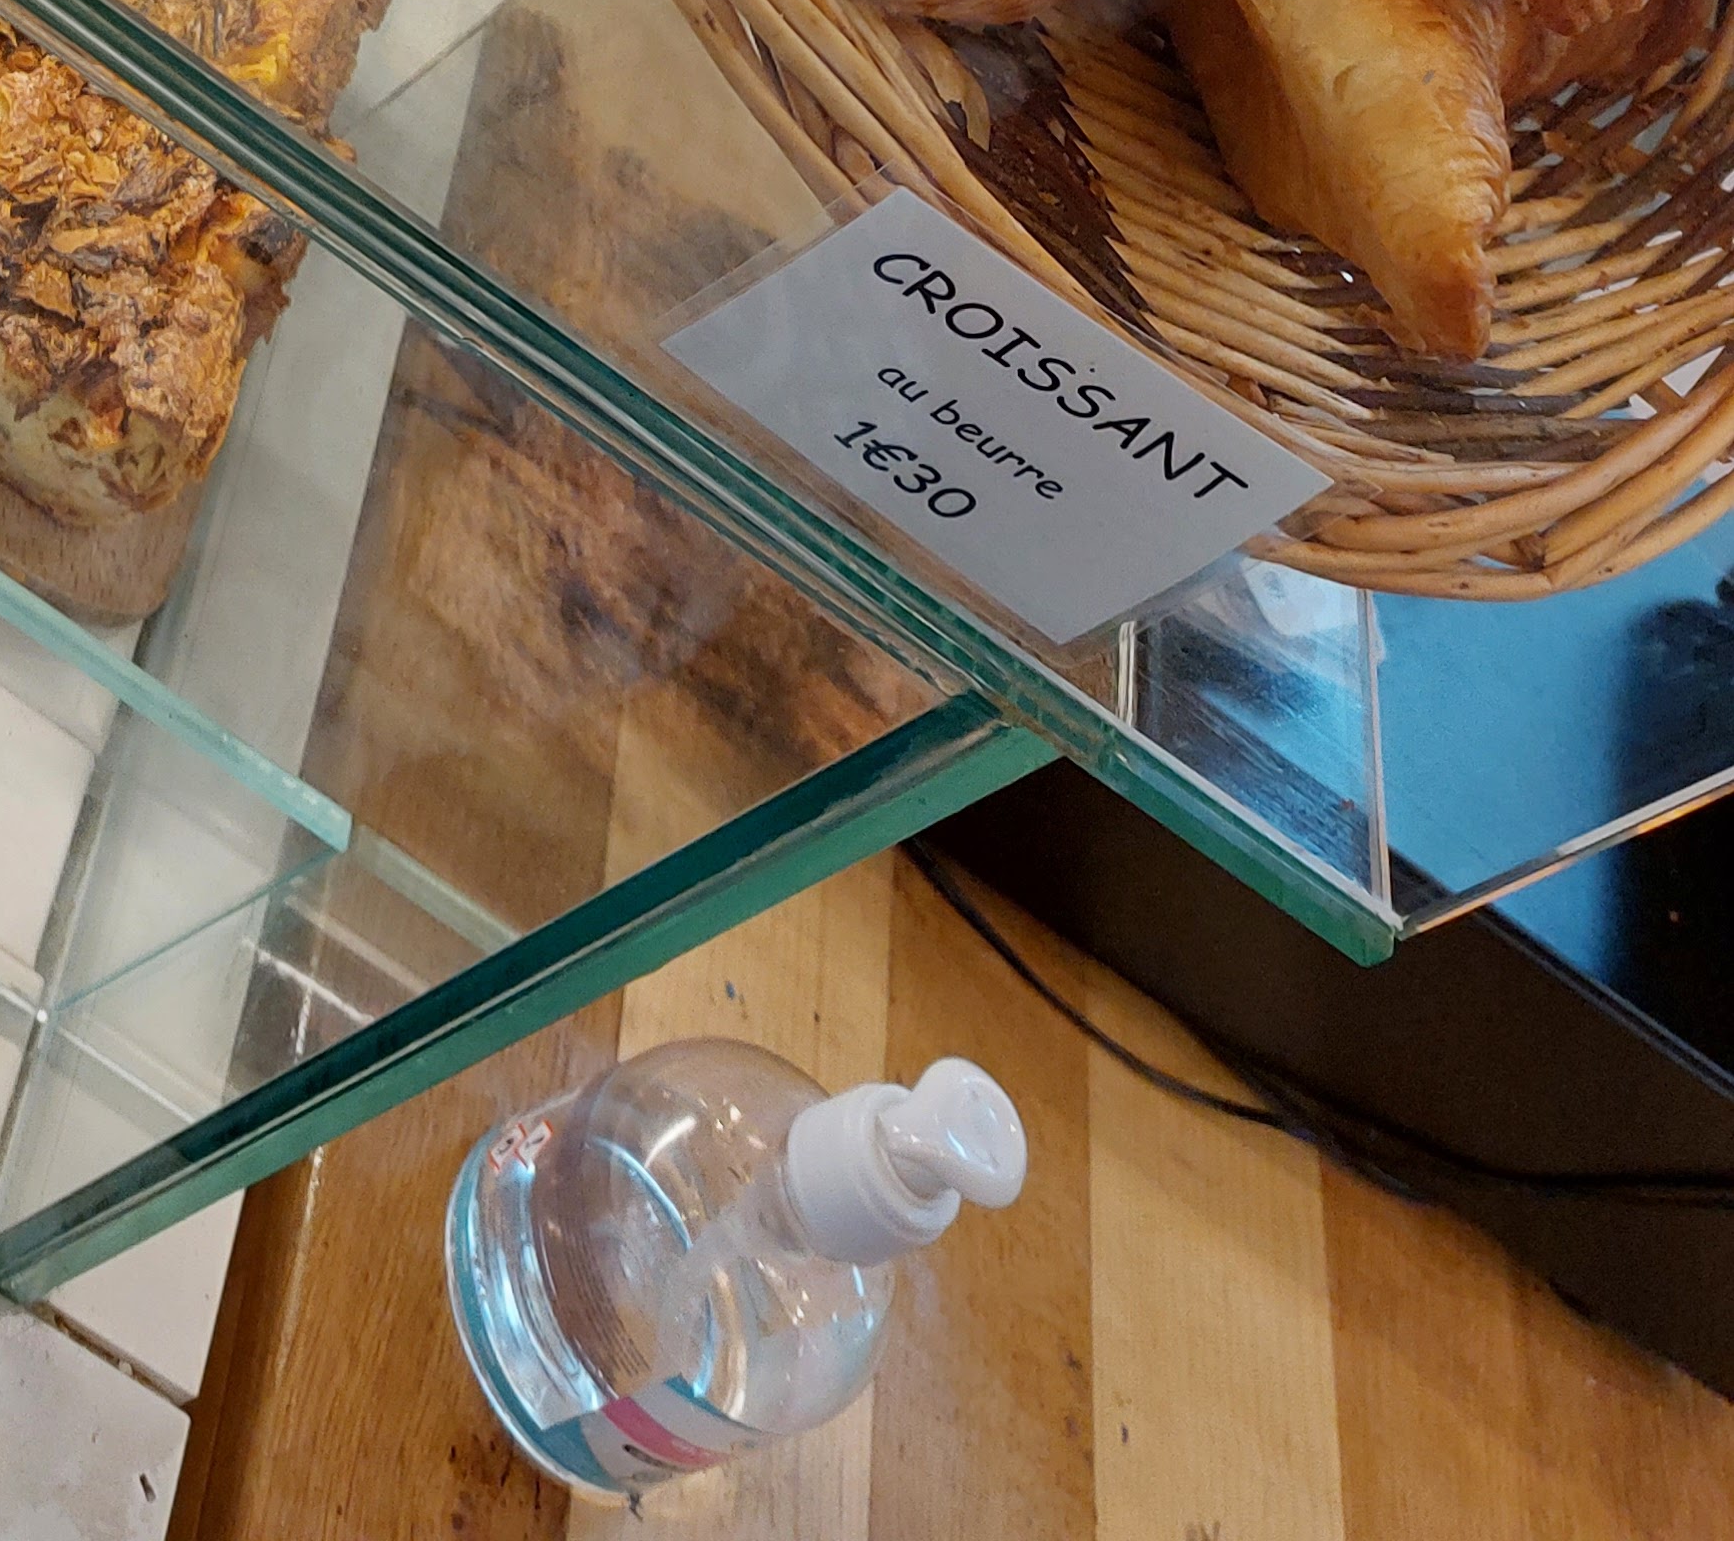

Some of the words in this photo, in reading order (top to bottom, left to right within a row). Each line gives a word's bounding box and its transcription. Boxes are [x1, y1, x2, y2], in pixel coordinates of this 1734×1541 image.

[872, 253, 1249, 499] CROISSANT
[877, 365, 928, 404] au
[929, 398, 1065, 501] beurre
[833, 420, 977, 519] 1€30
